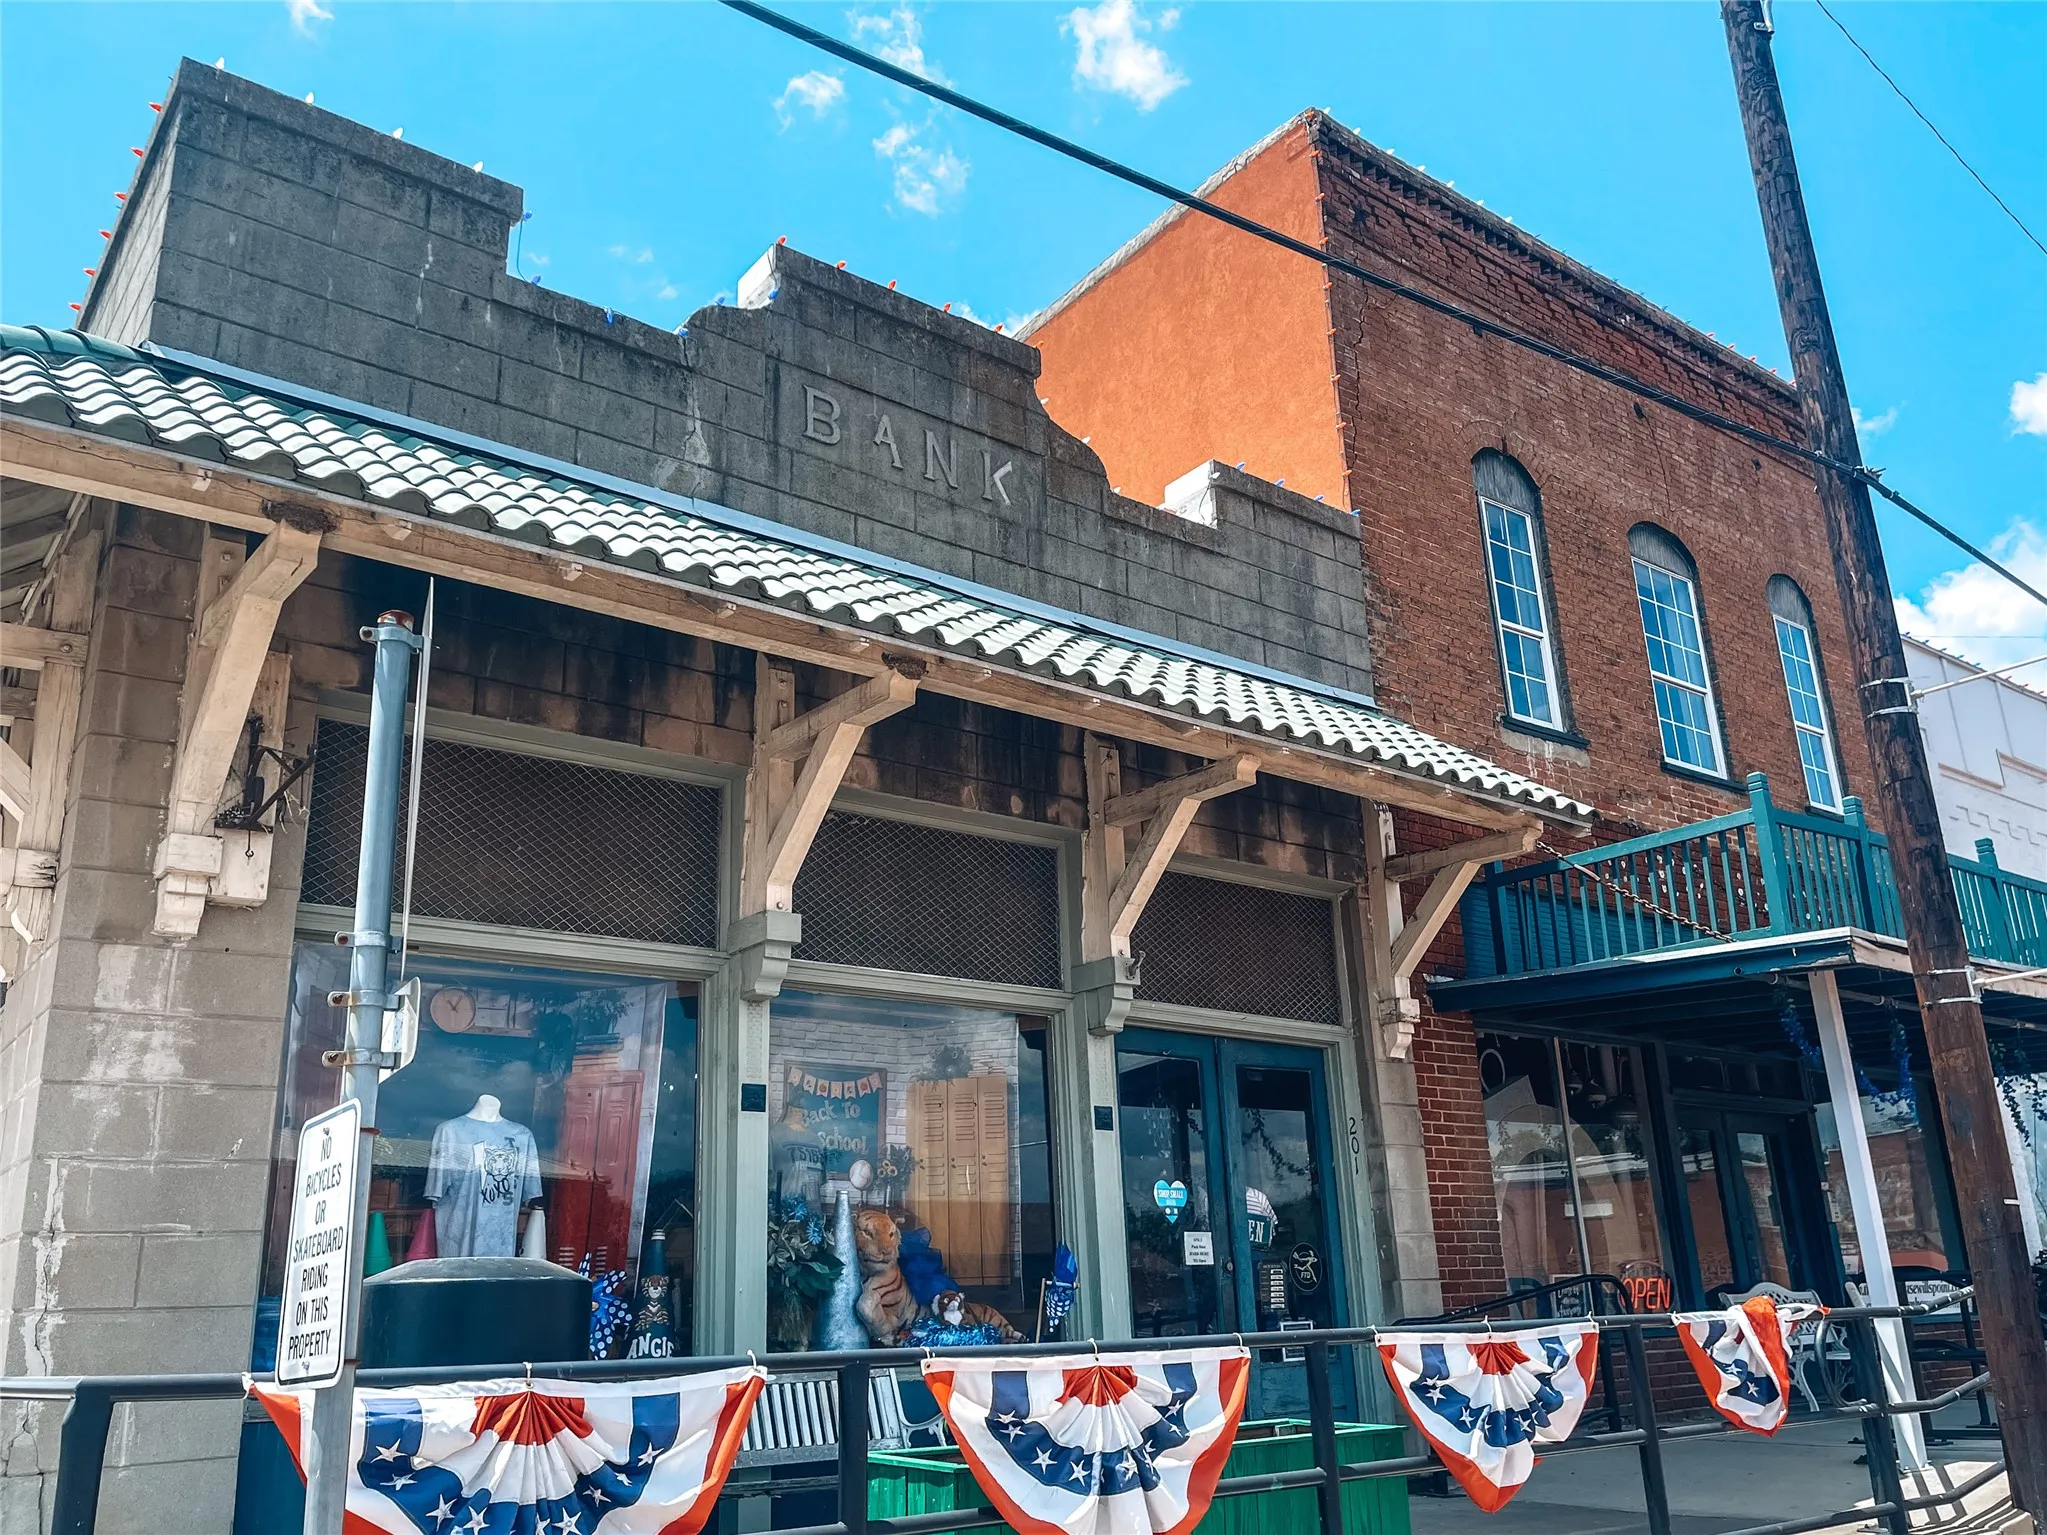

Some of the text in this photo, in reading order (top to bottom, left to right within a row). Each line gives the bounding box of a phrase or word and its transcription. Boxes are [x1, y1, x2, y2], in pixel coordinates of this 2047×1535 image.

[802, 384, 1013, 506] BANK
[321, 1136, 332, 1162] NO
[817, 1126, 869, 1154] School
[1348, 1116, 1360, 1176] 201
[306, 1163, 342, 1198] BICYCLES
[1170, 1190, 1184, 1199] SMALL
[315, 1200, 327, 1225] OR
[293, 1226, 344, 1263] SKATEBOARD
[1248, 1219, 1265, 1243] EN
[301, 1262, 328, 1292] RIDING
[1620, 1278, 1671, 1309] OPEN
[296, 1296, 329, 1326] ON THIS
[288, 1329, 331, 1360] PROPERTY
